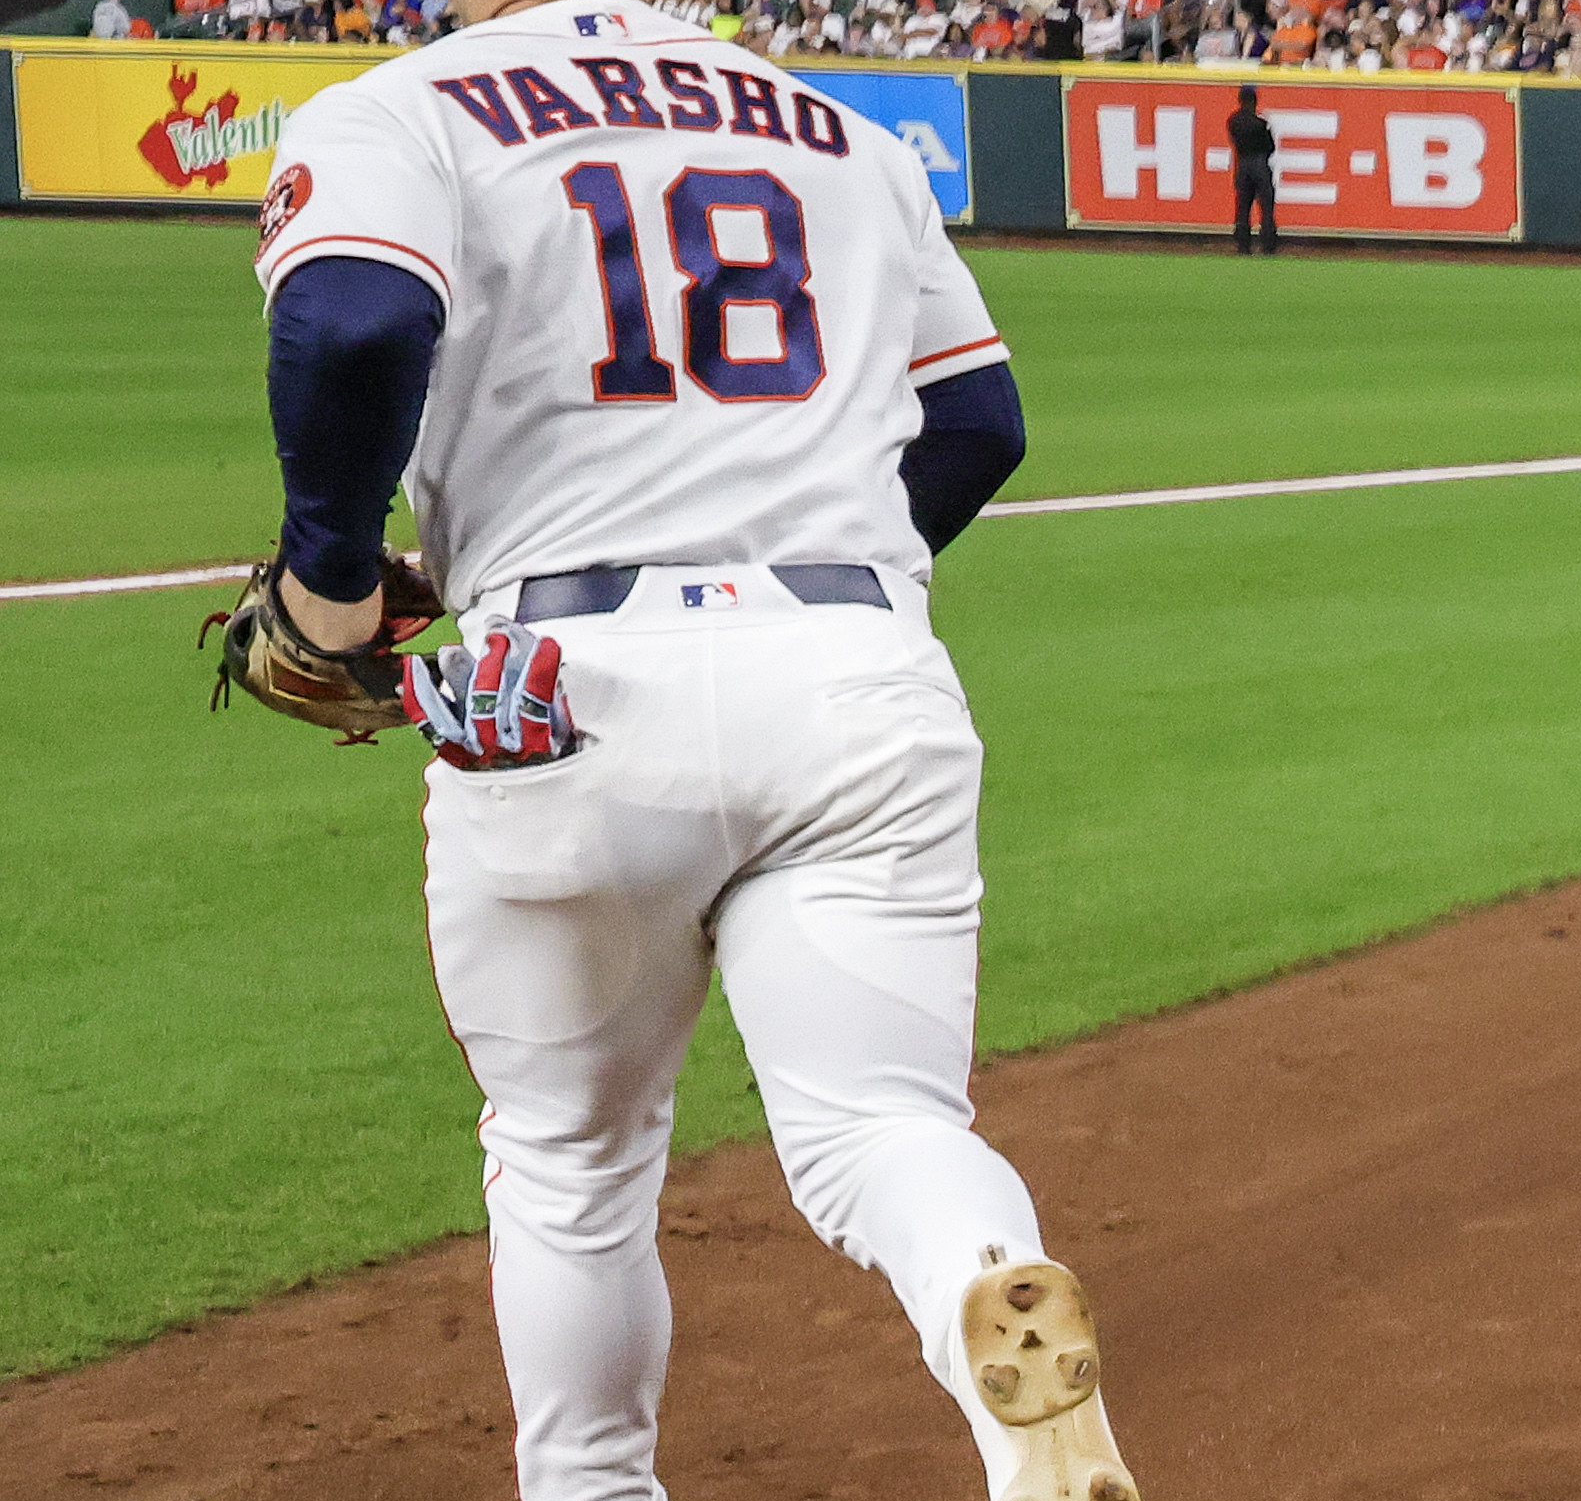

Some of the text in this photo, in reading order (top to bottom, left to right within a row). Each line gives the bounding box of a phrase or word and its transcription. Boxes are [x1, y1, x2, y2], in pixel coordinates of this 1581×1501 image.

[166, 96, 284, 175] Valenti
[434, 57, 850, 158] VARSHO
[1097, 105, 1487, 207] H-E-B
[561, 160, 827, 403] 18
